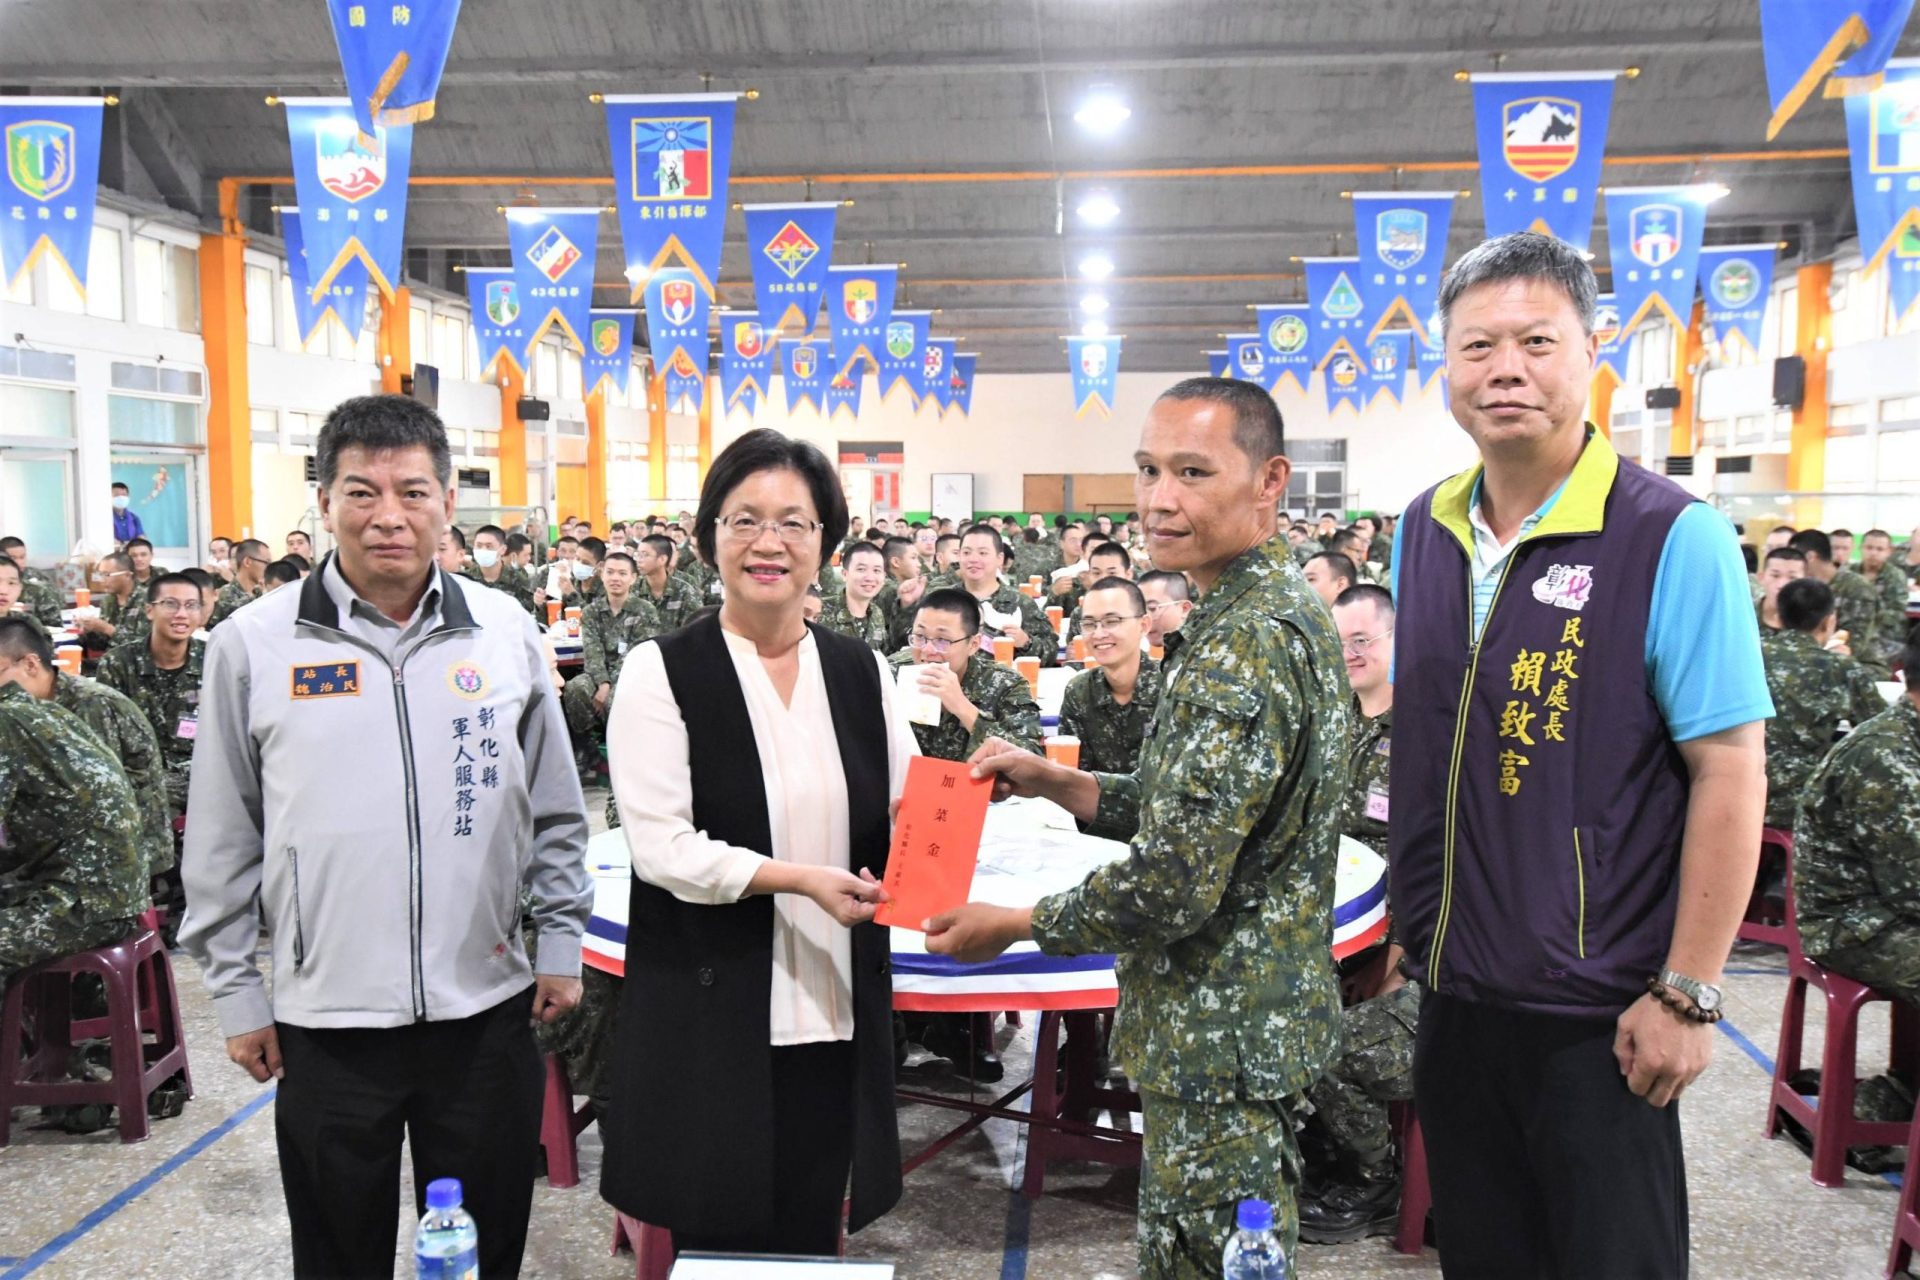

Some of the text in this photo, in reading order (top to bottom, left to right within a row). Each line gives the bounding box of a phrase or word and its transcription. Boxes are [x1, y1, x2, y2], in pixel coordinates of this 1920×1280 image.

[640, 204, 707, 220] 東引指揮部
[295, 680, 357, 695] 魏治民
[302, 665, 349, 679] 站長
[1542, 616, 1584, 742] 民政處長
[477, 706, 500, 789] 彰化縣
[1499, 648, 1546, 796] 賴致富
[452, 717, 477, 837] 軍人服務站
[927, 774, 955, 857] 加菜金
